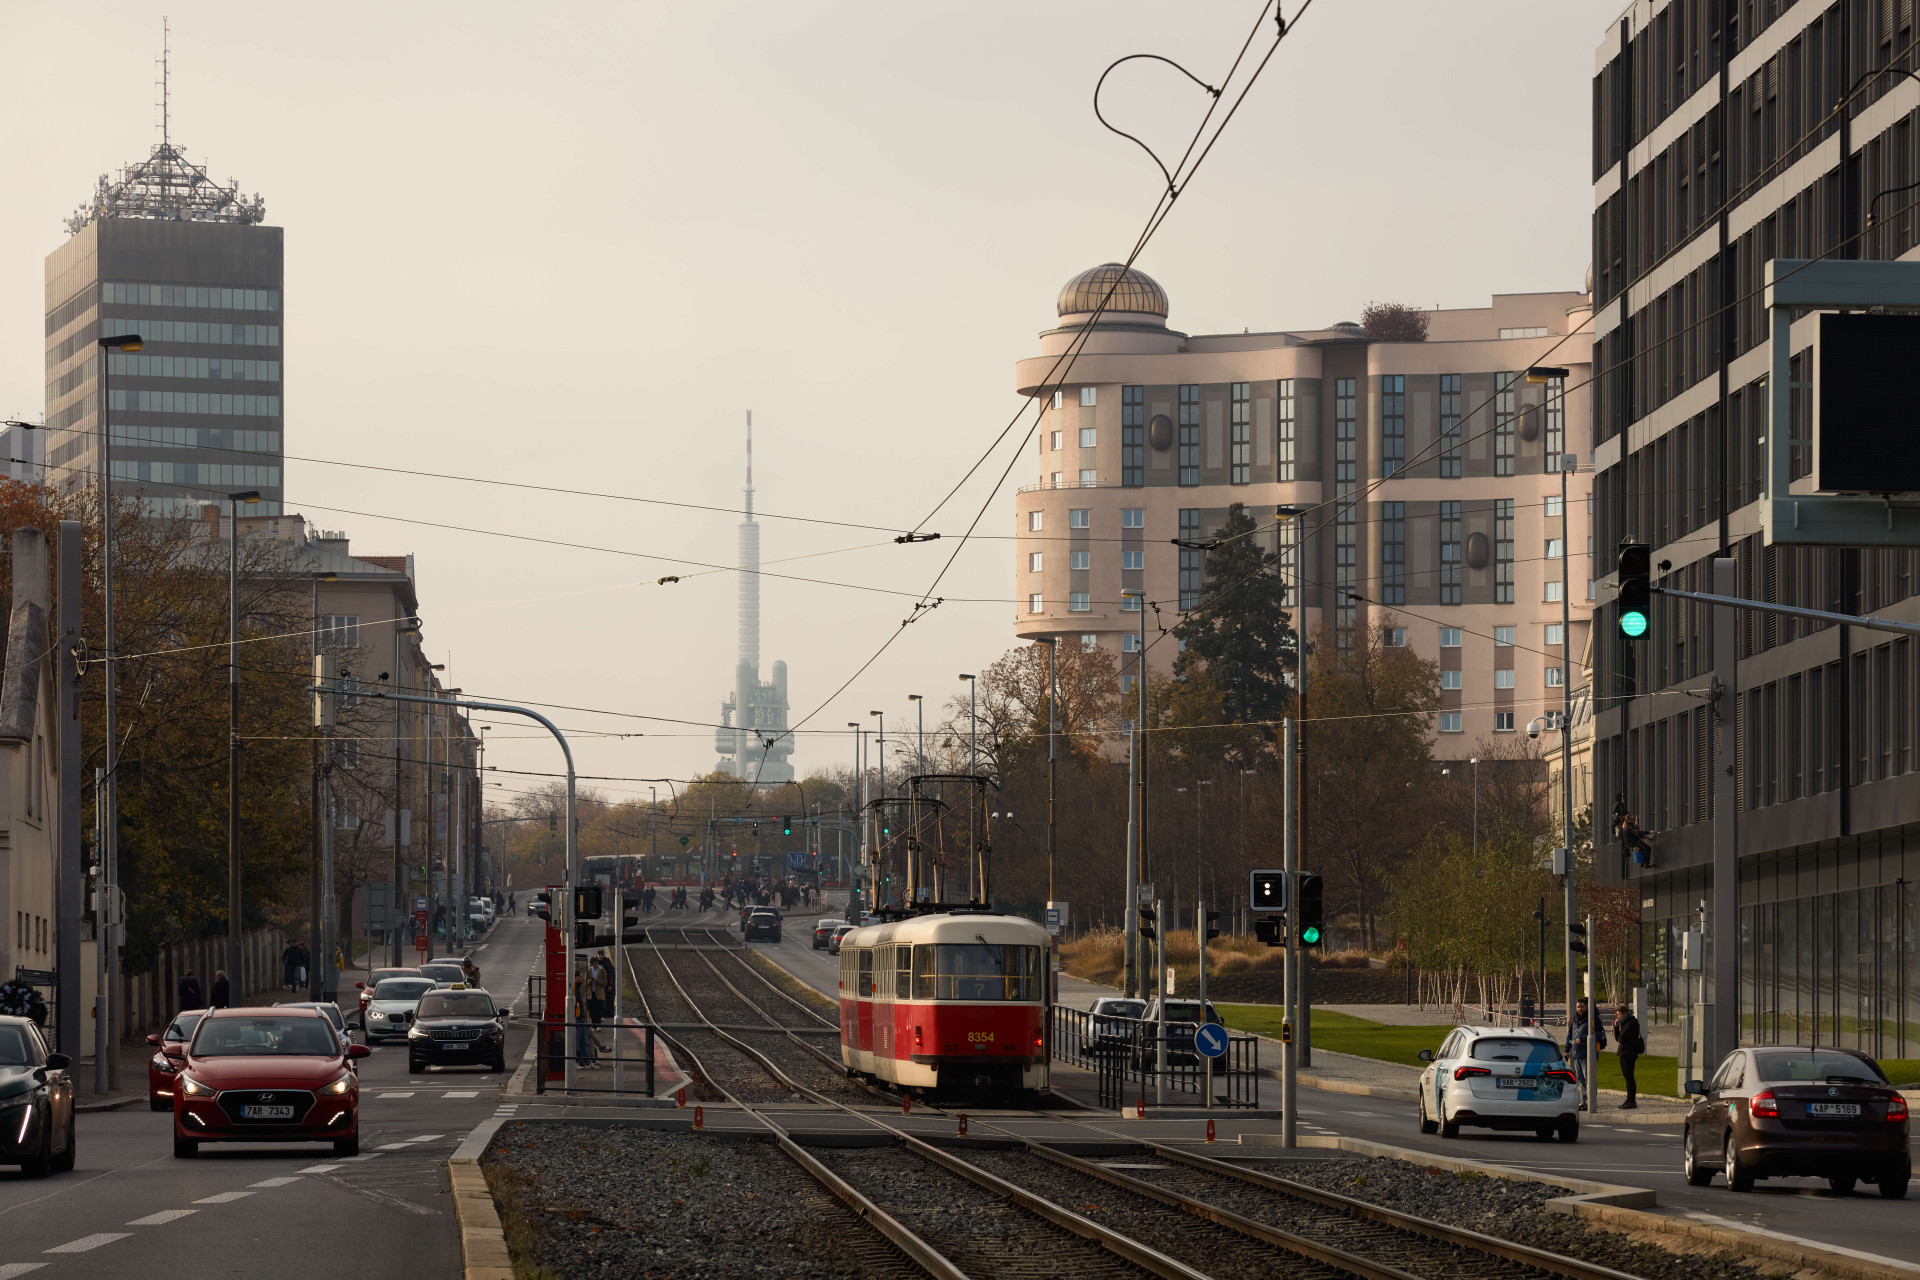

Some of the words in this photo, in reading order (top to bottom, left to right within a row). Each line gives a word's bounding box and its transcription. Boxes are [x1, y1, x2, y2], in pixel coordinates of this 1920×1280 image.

[968, 1032, 994, 1042] 8354
[247, 1106, 262, 1115] 7AR
[269, 1106, 289, 1116] 7343
[1814, 1104, 1829, 1113] 4AP
[1835, 1105, 1857, 1114] 5169
